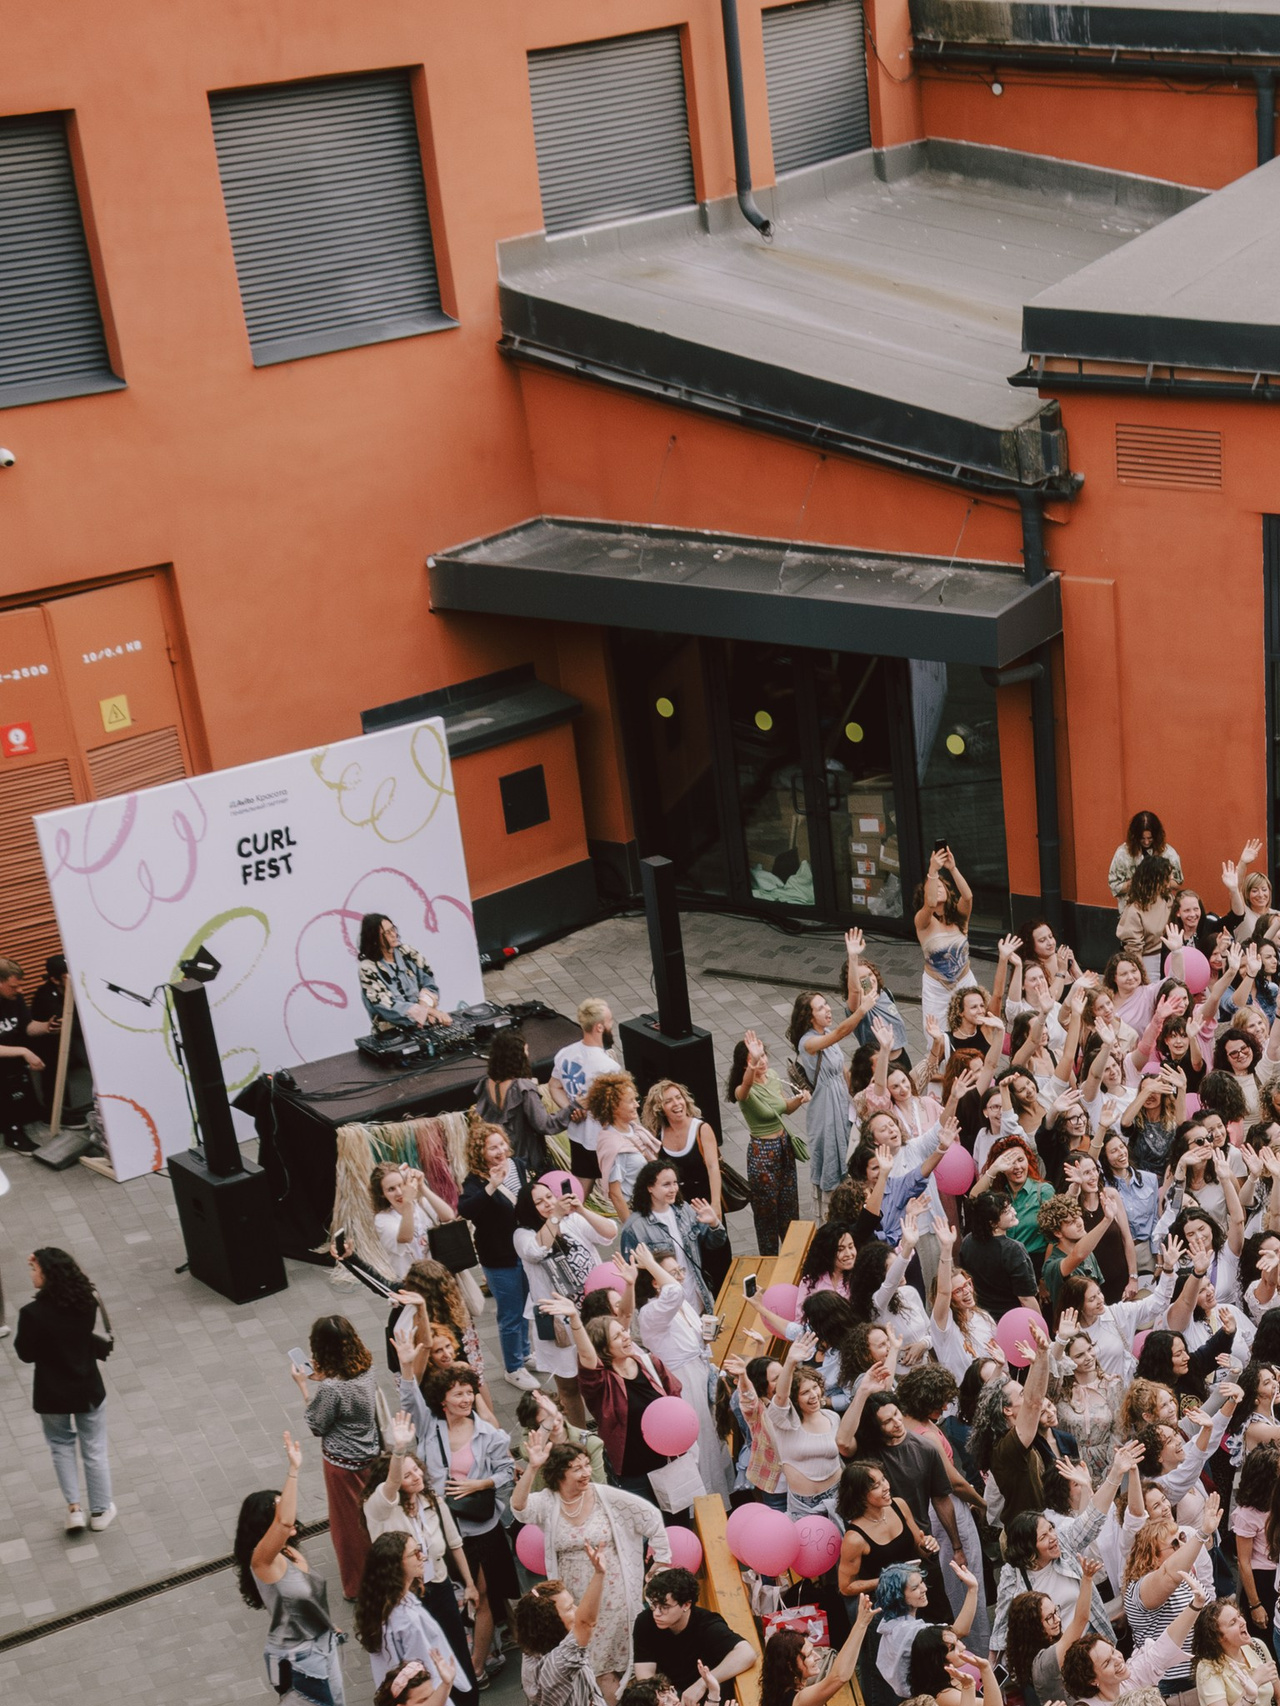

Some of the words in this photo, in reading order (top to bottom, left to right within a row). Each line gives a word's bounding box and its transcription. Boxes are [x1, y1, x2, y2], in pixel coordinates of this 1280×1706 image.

[0, 664, 48, 683] -2500
[237, 826, 297, 858] CURL
[242, 853, 292, 885] FEST
